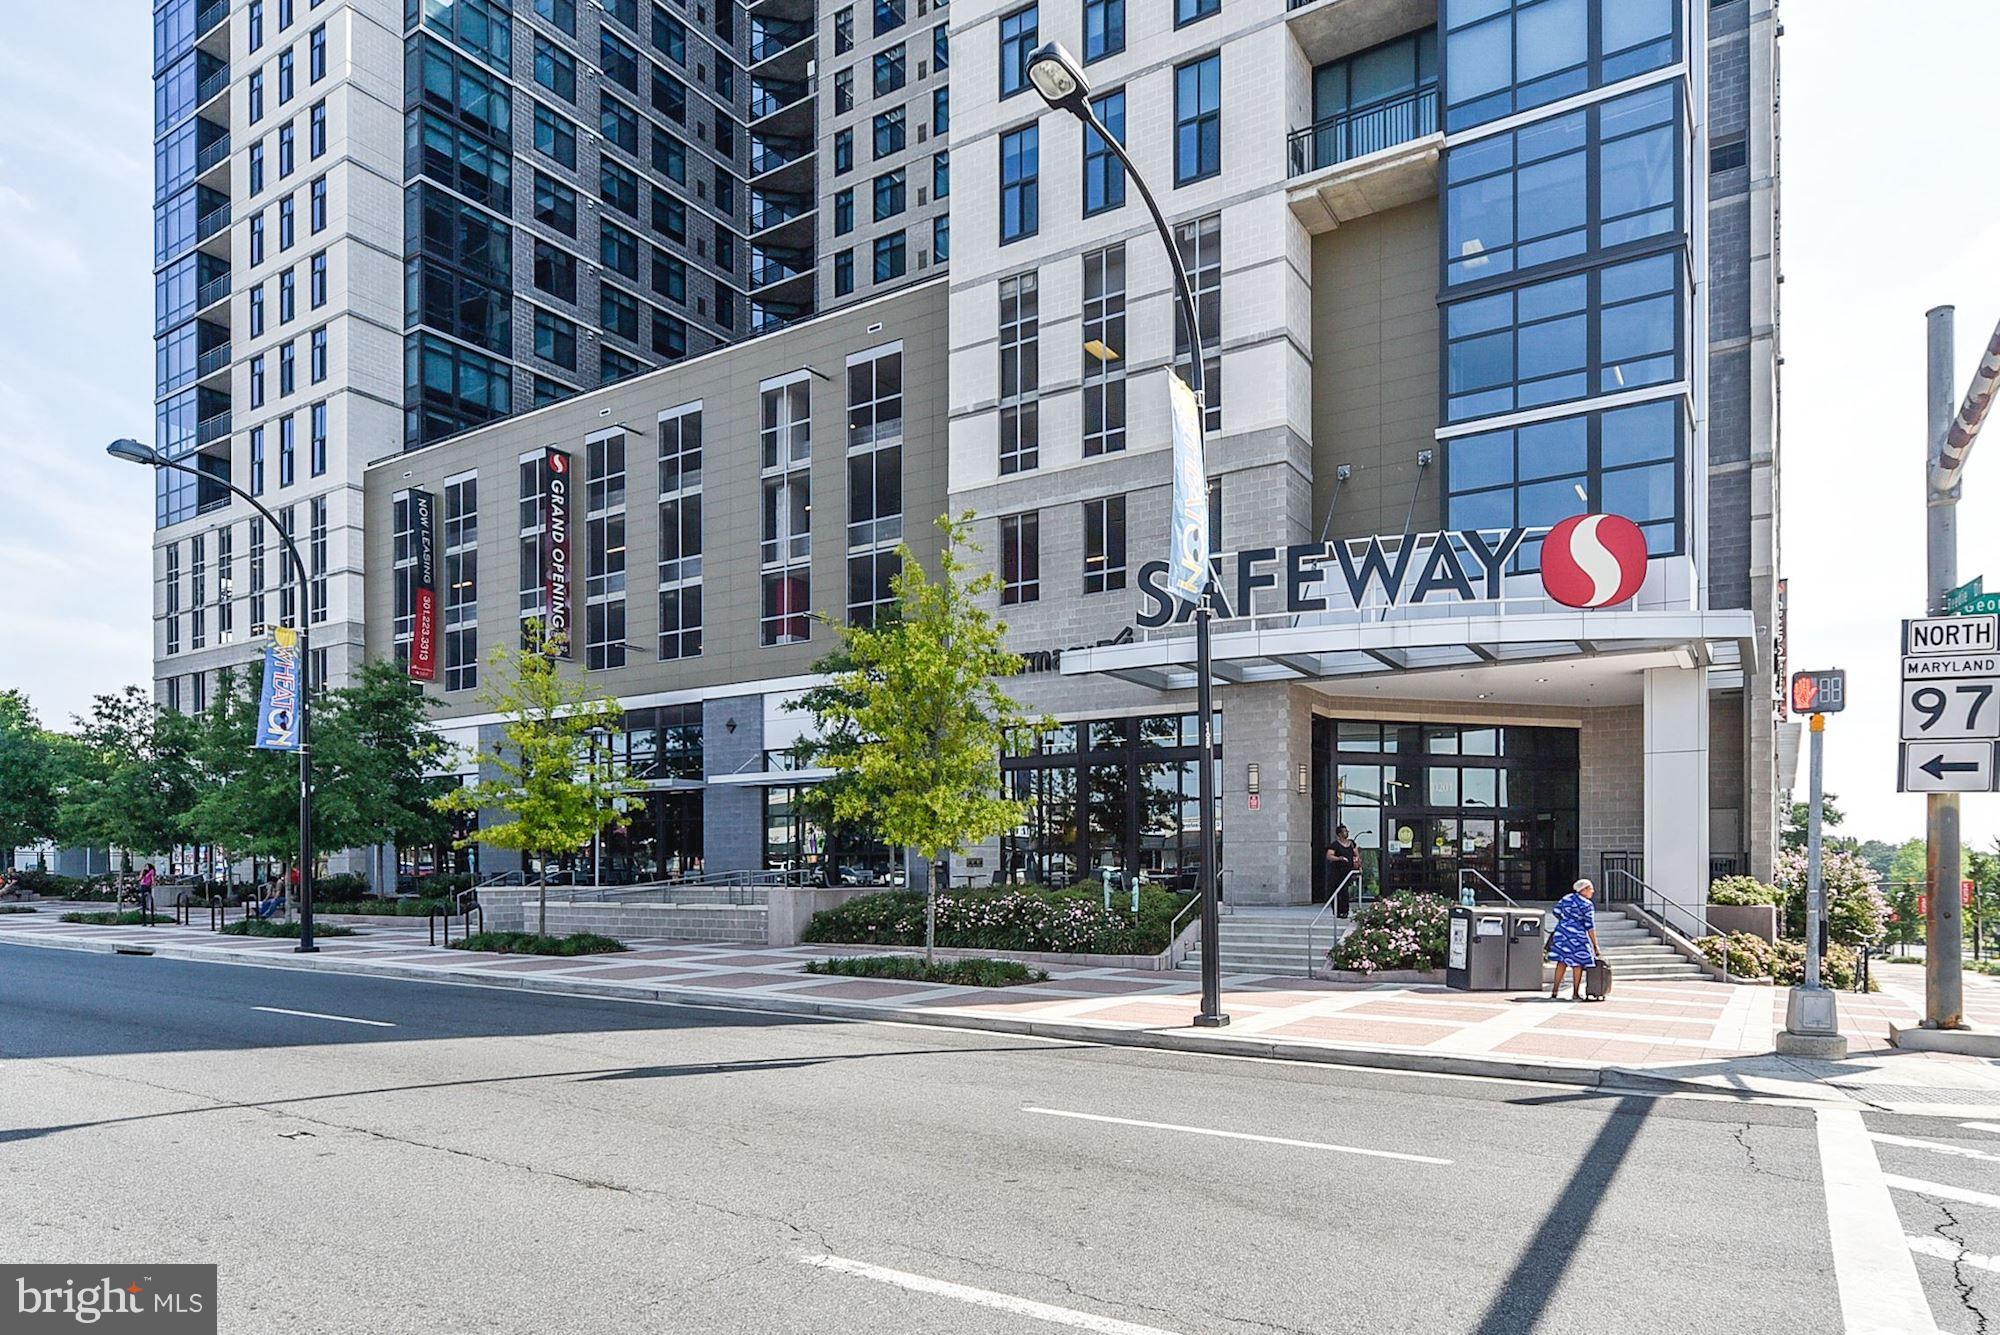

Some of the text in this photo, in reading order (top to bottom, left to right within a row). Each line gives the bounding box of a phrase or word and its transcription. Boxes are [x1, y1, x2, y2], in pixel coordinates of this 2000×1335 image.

[416, 497, 432, 584] NOW LEASING
[550, 478, 565, 543] GRAND
[550, 548, 565, 628] OPENING
[418, 596, 432, 662] 301.223.3313
[1914, 622, 1990, 647] NORTH
[265, 645, 297, 747] WHEATON
[1908, 659, 1995, 674] MARYLAND
[1911, 685, 1993, 732] 97
